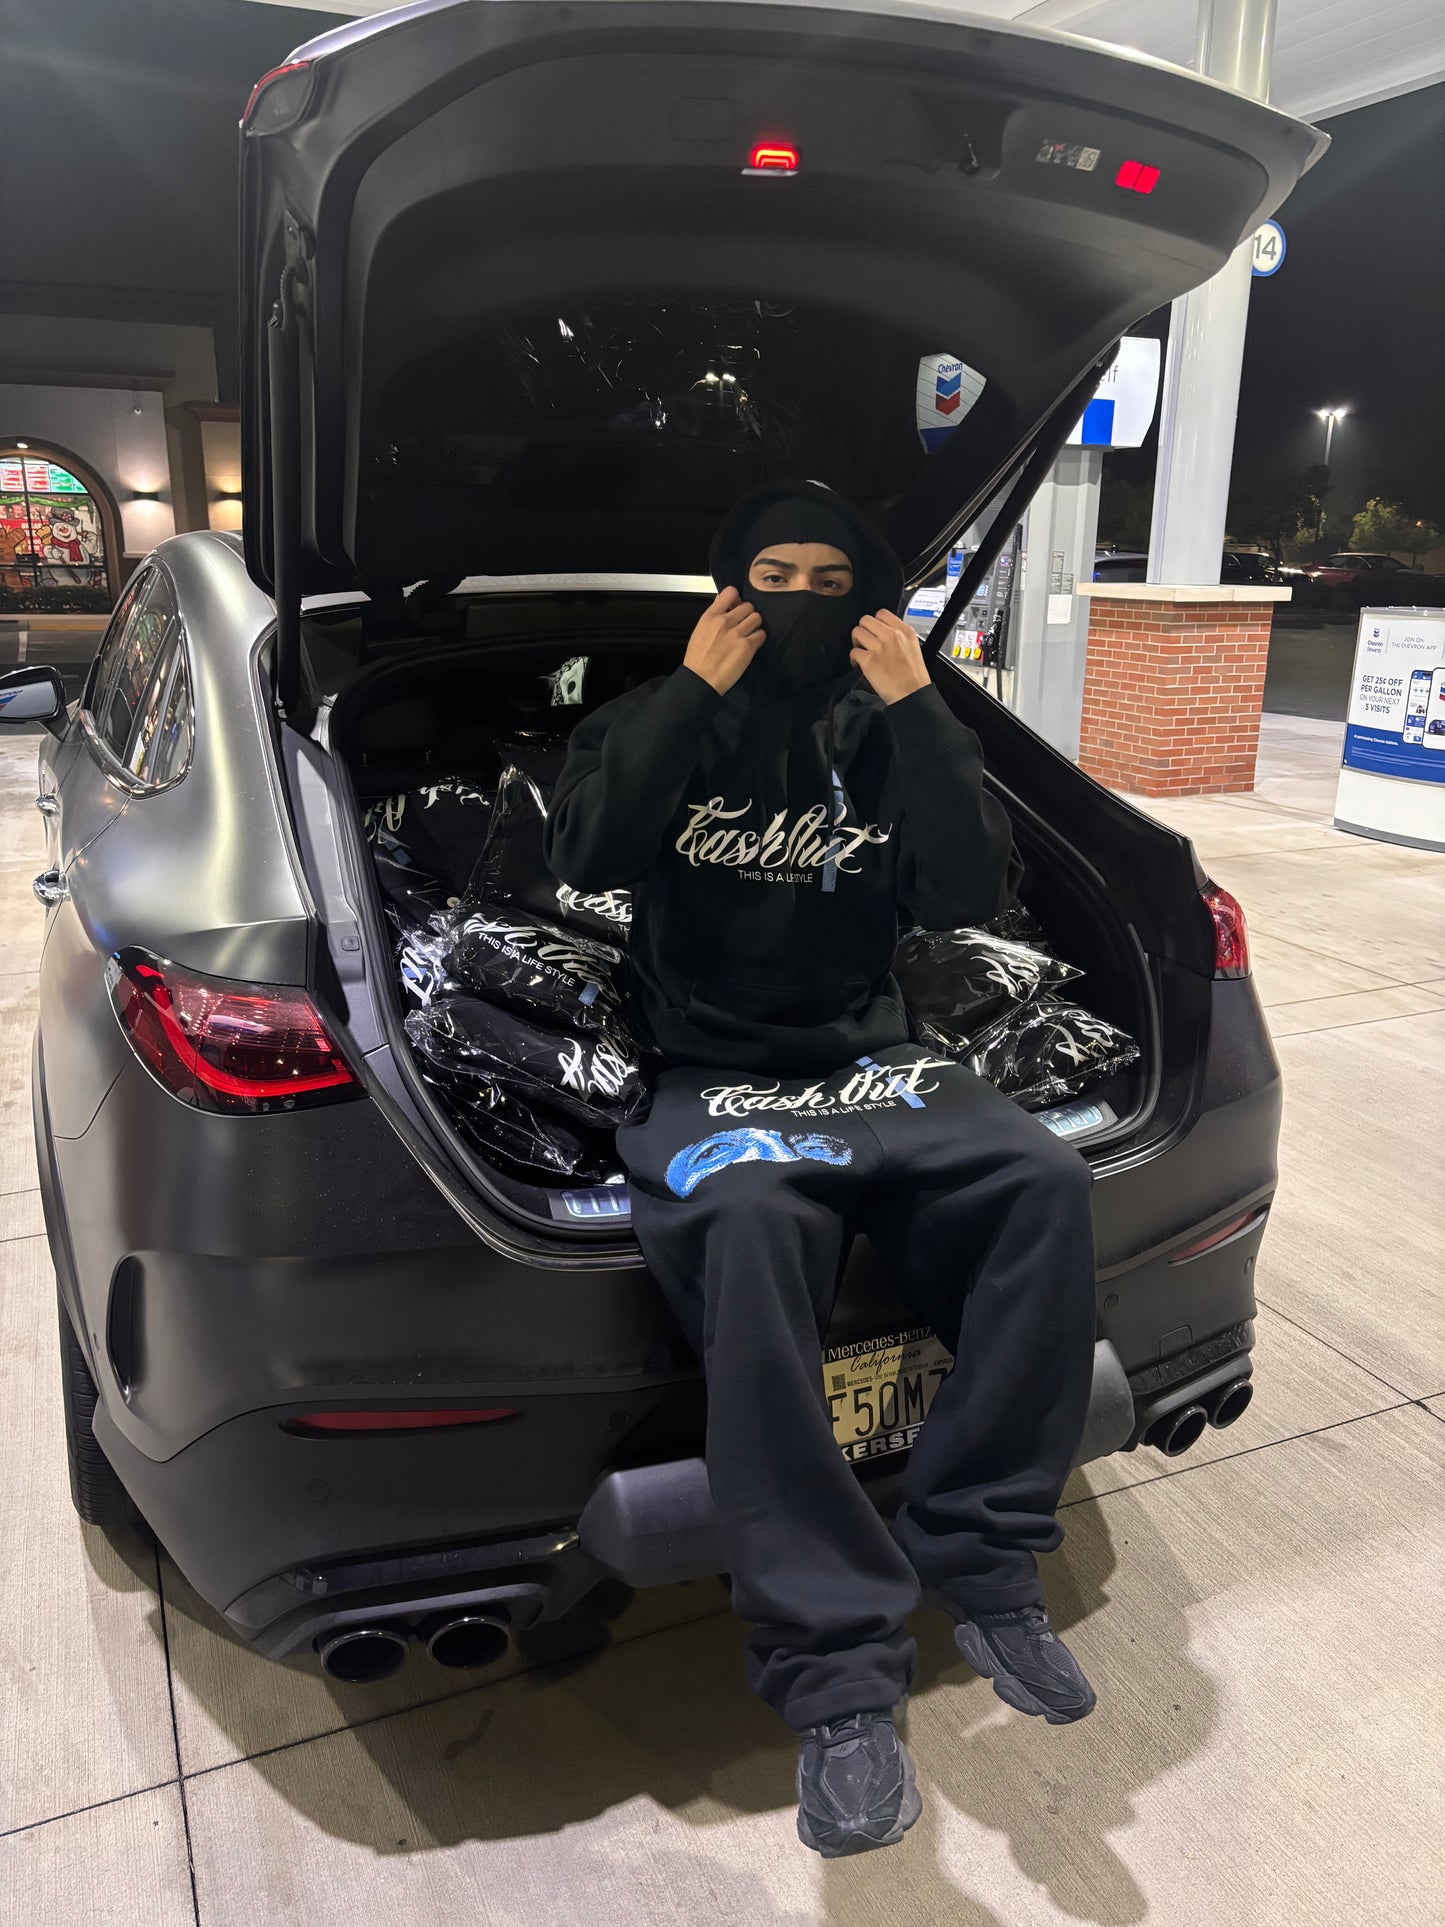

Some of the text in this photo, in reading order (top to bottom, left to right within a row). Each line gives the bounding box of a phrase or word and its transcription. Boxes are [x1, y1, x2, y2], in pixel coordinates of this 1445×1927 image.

[1255, 234, 1277, 261] 14
[938, 362, 963, 374] Chevron
[1362, 674, 1403, 687] GET 25¢ OFF
[1360, 683, 1402, 697] PER GALLON
[1359, 693, 1401, 705] ON YOUR NEXT
[1364, 703, 1391, 714] 5 VISITS
[737, 869, 762, 881] THIS
[764, 871, 774, 882] IS
[775, 872, 785, 882] A
[478, 932, 576, 988] THIS IS A LIFE STYLE
[701, 1056, 957, 1117] Cash Out
[791, 1100, 897, 1118] THIS IS A LIFE STYLE
[851, 1347, 922, 1375] California
